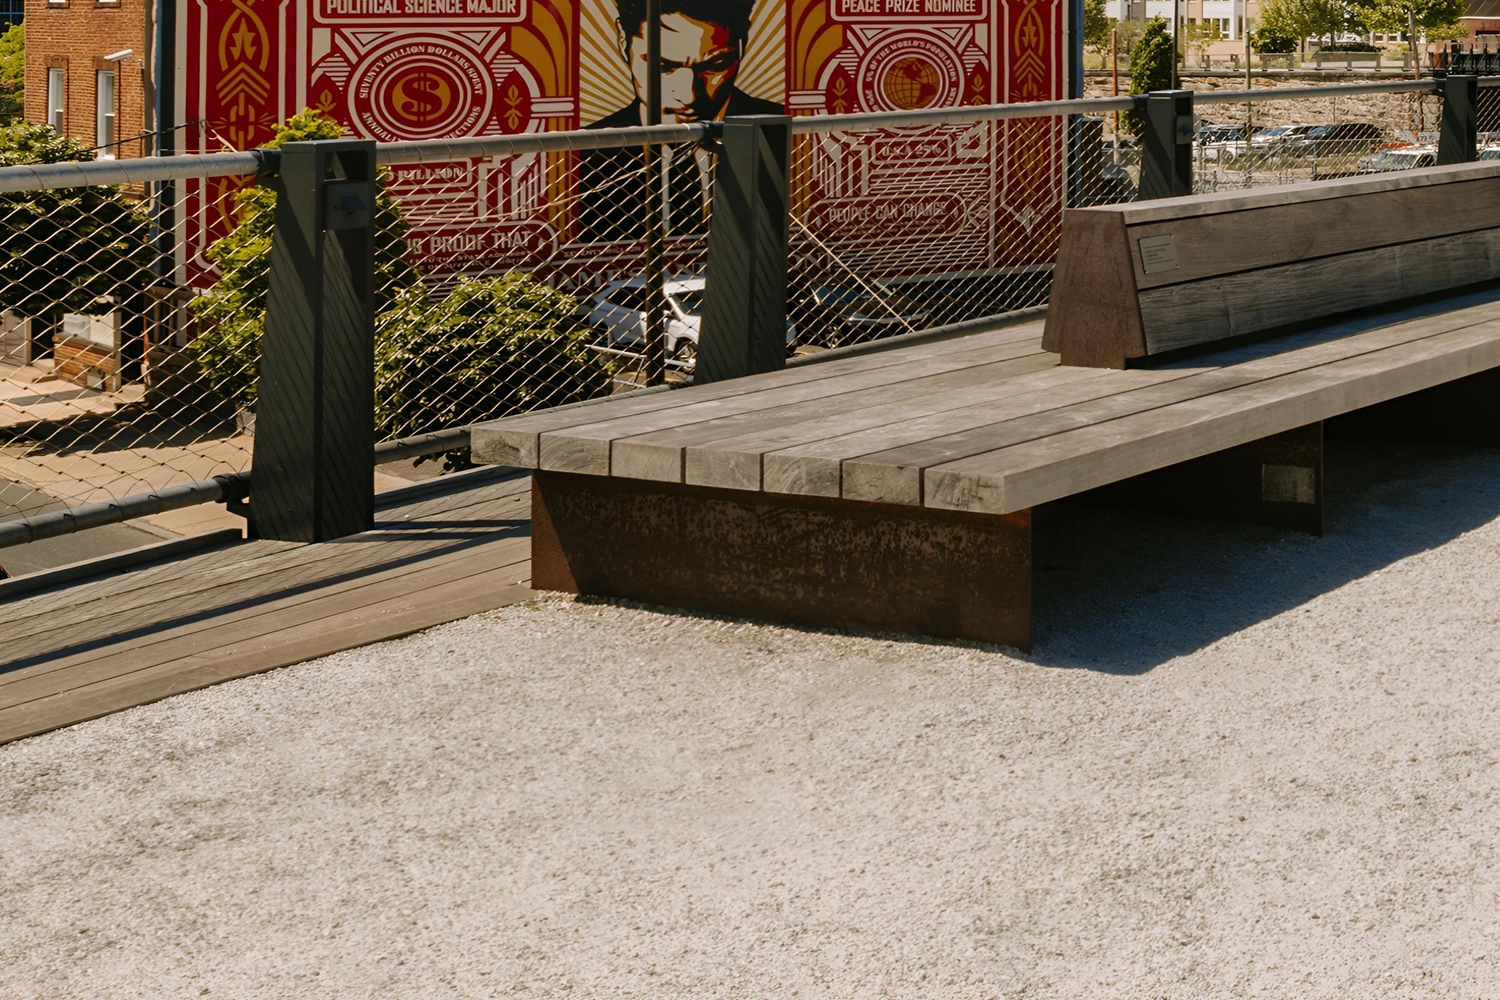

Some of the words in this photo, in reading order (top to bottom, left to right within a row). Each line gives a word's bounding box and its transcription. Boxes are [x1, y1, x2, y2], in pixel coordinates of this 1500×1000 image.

[359, 60, 385, 99] SEVENTY
[383, 45, 426, 64] BILLION
[427, 45, 471, 69] DOLLARS
[467, 67, 484, 95] SPENT
[875, 47, 891, 61] THE
[925, 42, 958, 82] POPULATION
[829, 206, 871, 223] PEOPLE
[875, 203, 898, 220] CAN
[903, 202, 946, 217] CHANGE
[430, 234, 486, 253] PROOF
[491, 231, 531, 249] THAT
